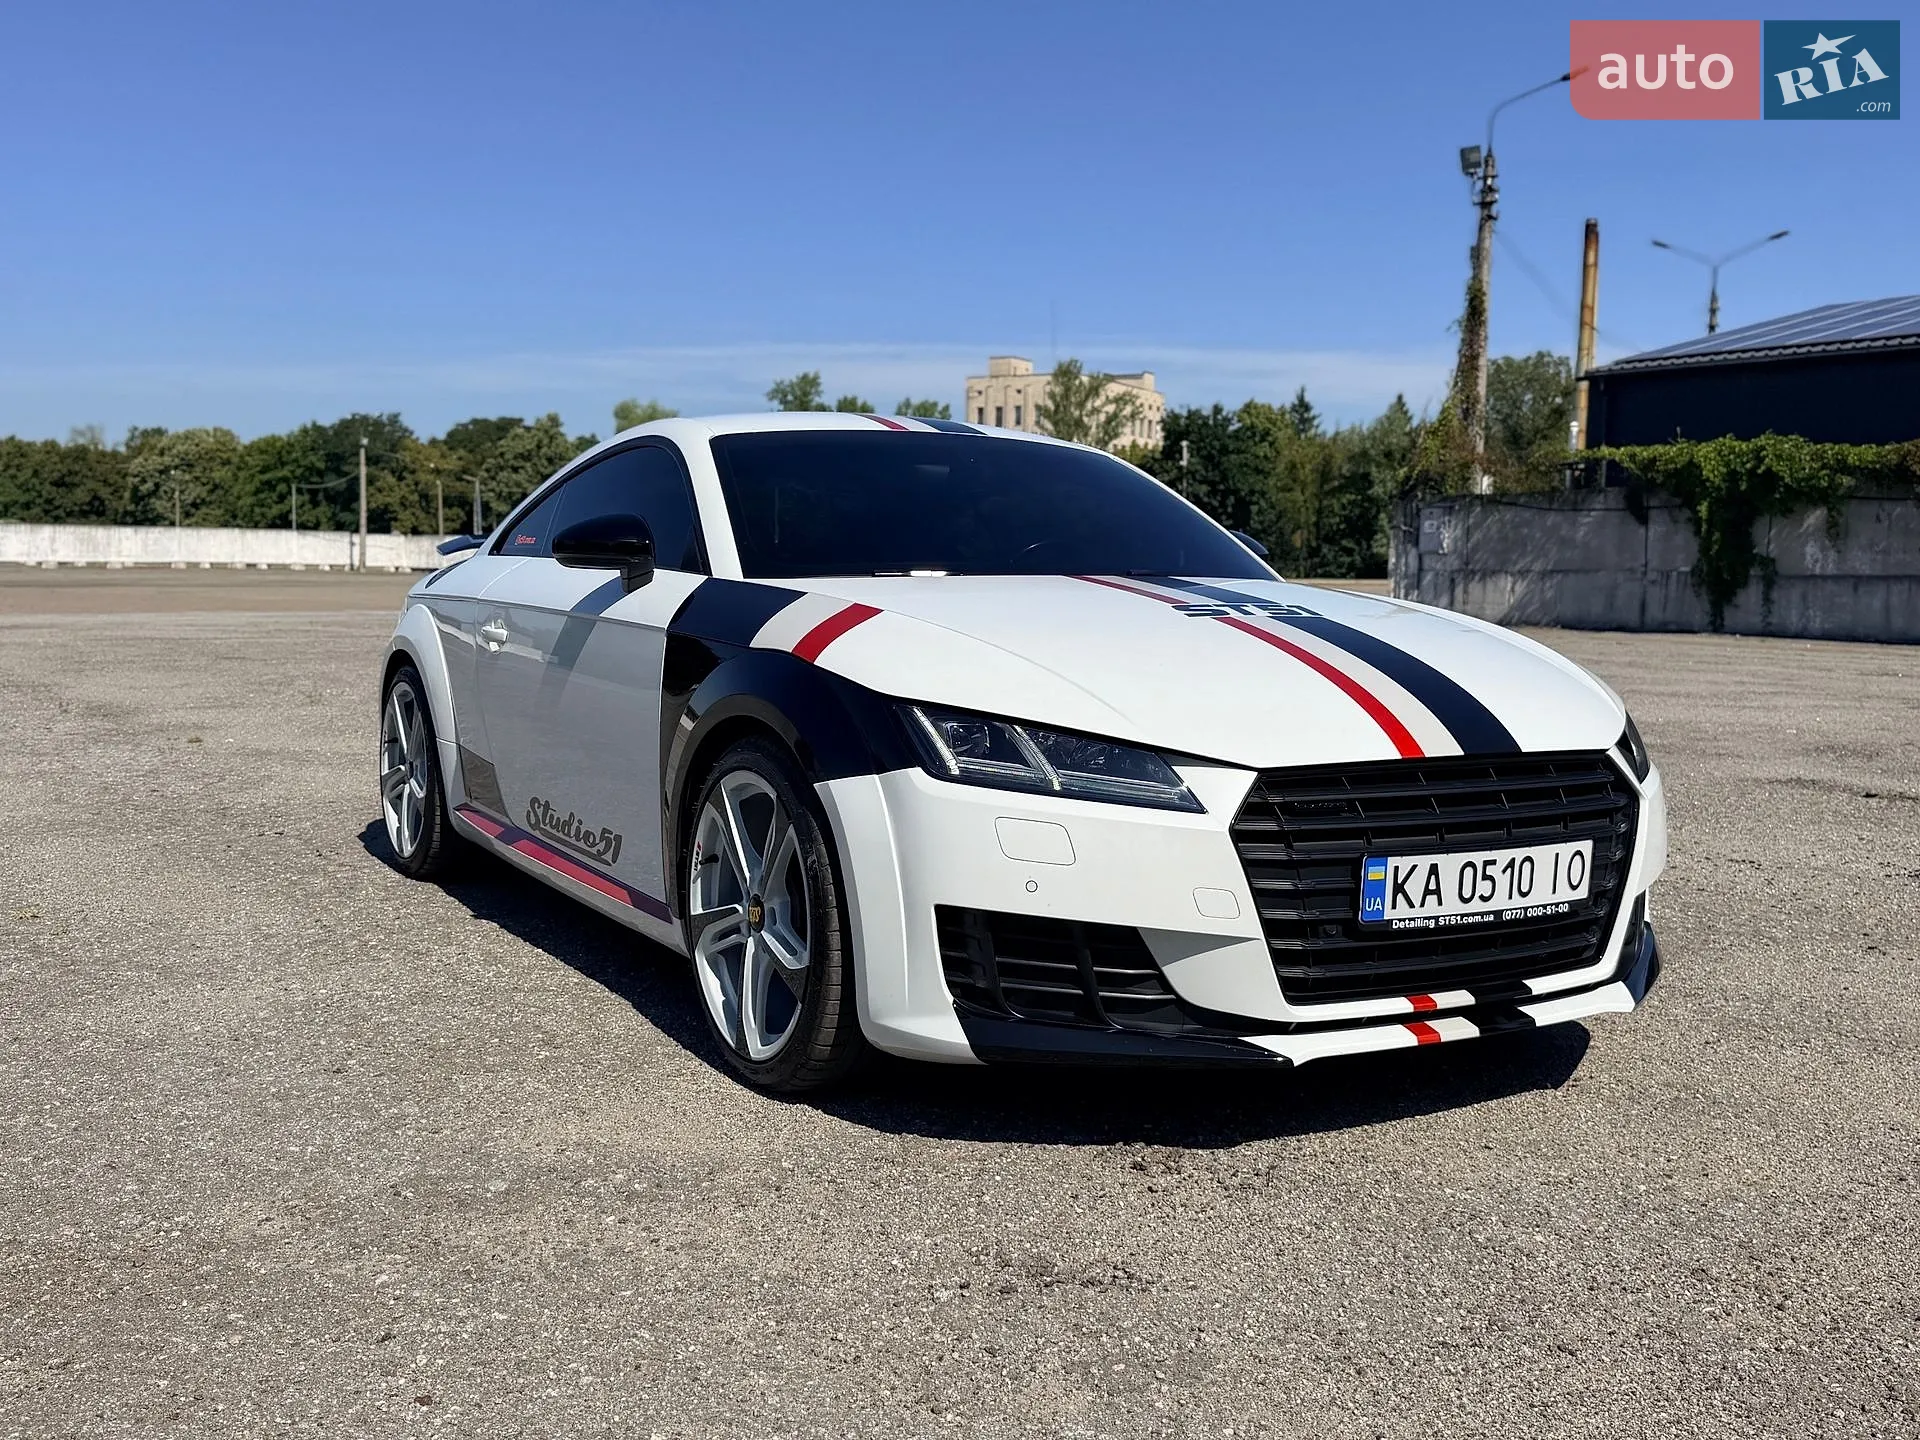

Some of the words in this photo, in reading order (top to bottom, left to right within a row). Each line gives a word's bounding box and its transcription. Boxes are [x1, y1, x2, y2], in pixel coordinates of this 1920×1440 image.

[526, 797, 622, 864] Studio51
[1391, 863, 1443, 910] KA
[1458, 856, 1535, 904] 0510
[1365, 898, 1383, 912] UA
[1392, 916, 1435, 929] Detailing
[1438, 913, 1495, 926] ST51.com.ua
[1502, 908, 1524, 920] (077)
[1526, 902, 1569, 918] 000-51-00
